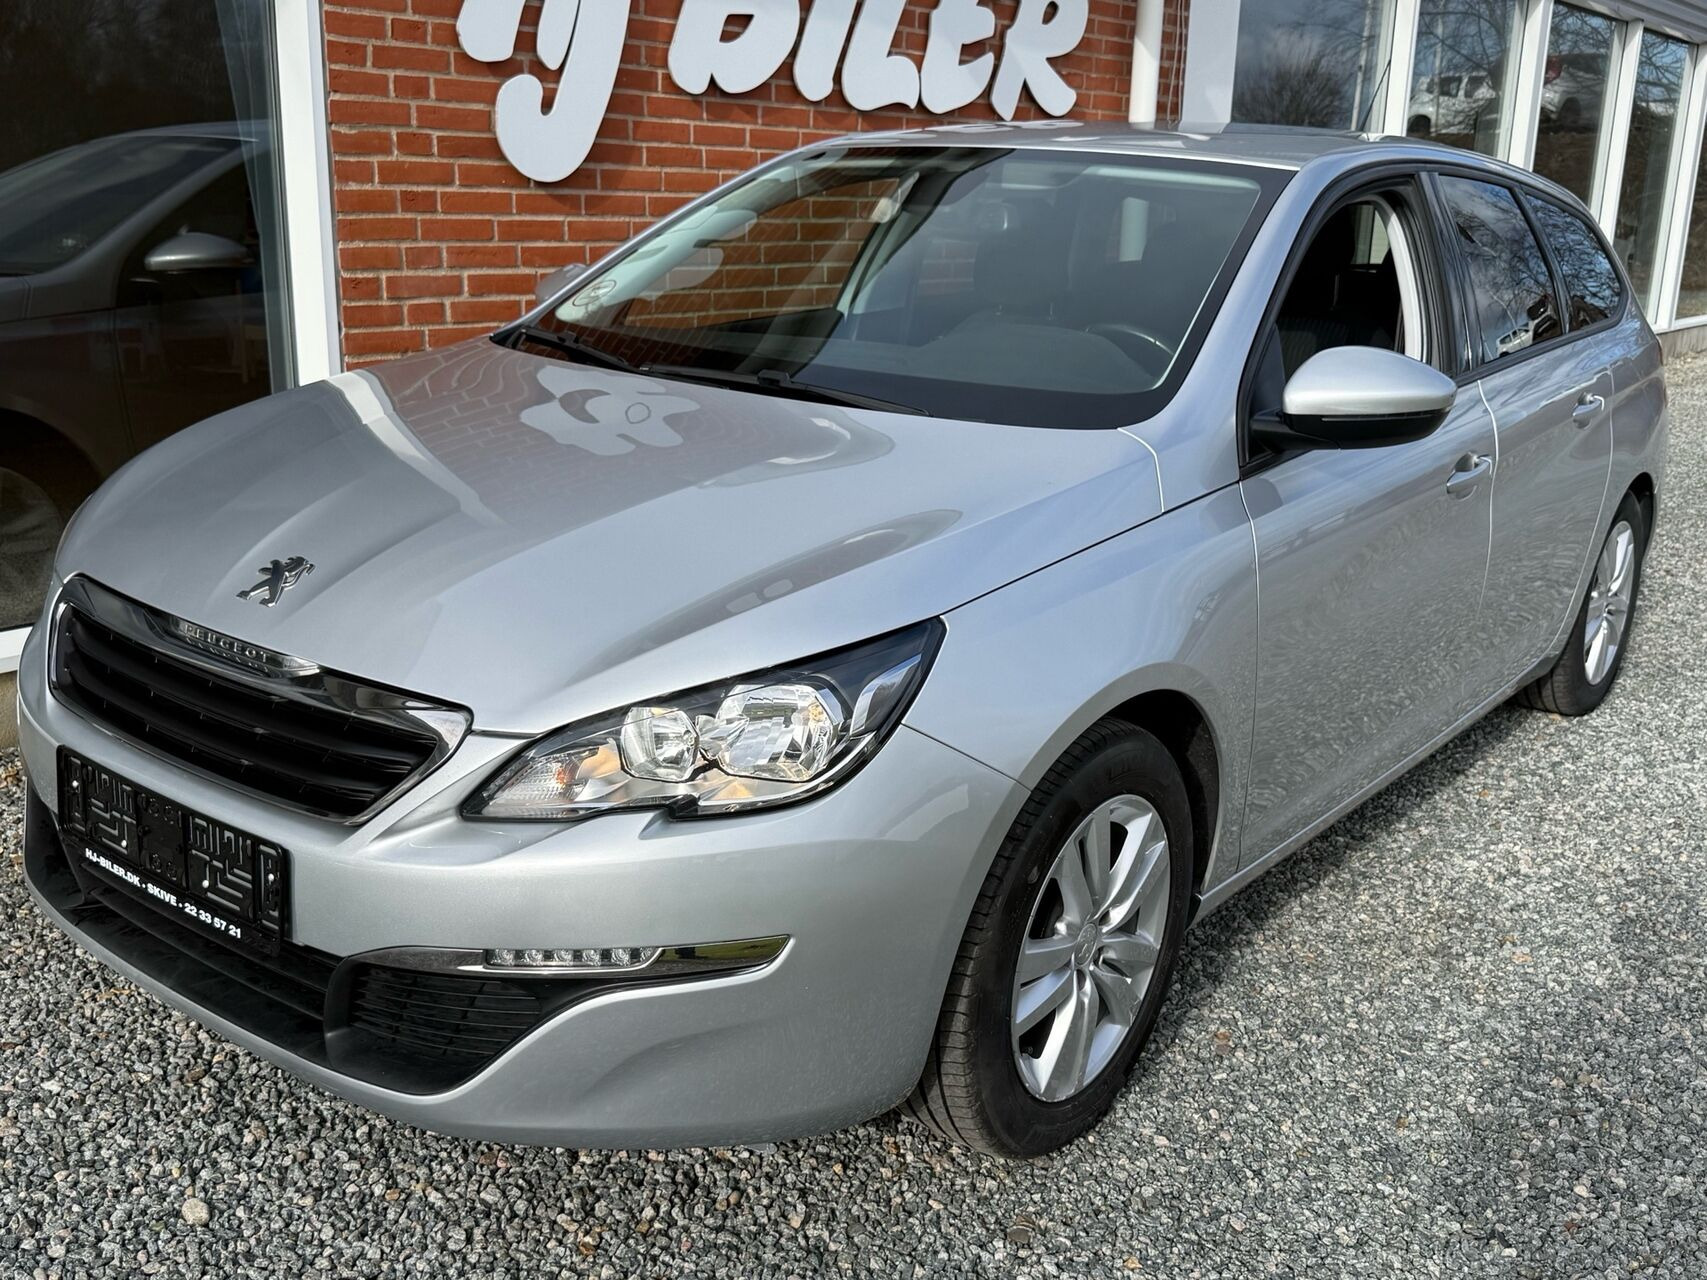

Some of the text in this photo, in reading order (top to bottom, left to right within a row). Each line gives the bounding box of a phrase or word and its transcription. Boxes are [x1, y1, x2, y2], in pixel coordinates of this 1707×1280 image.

[667, 0, 1088, 121] BILER
[183, 623, 272, 663] PEUGEOT
[85, 848, 242, 939] HJ-BILER.DK SKIVE 22 33 57 21
